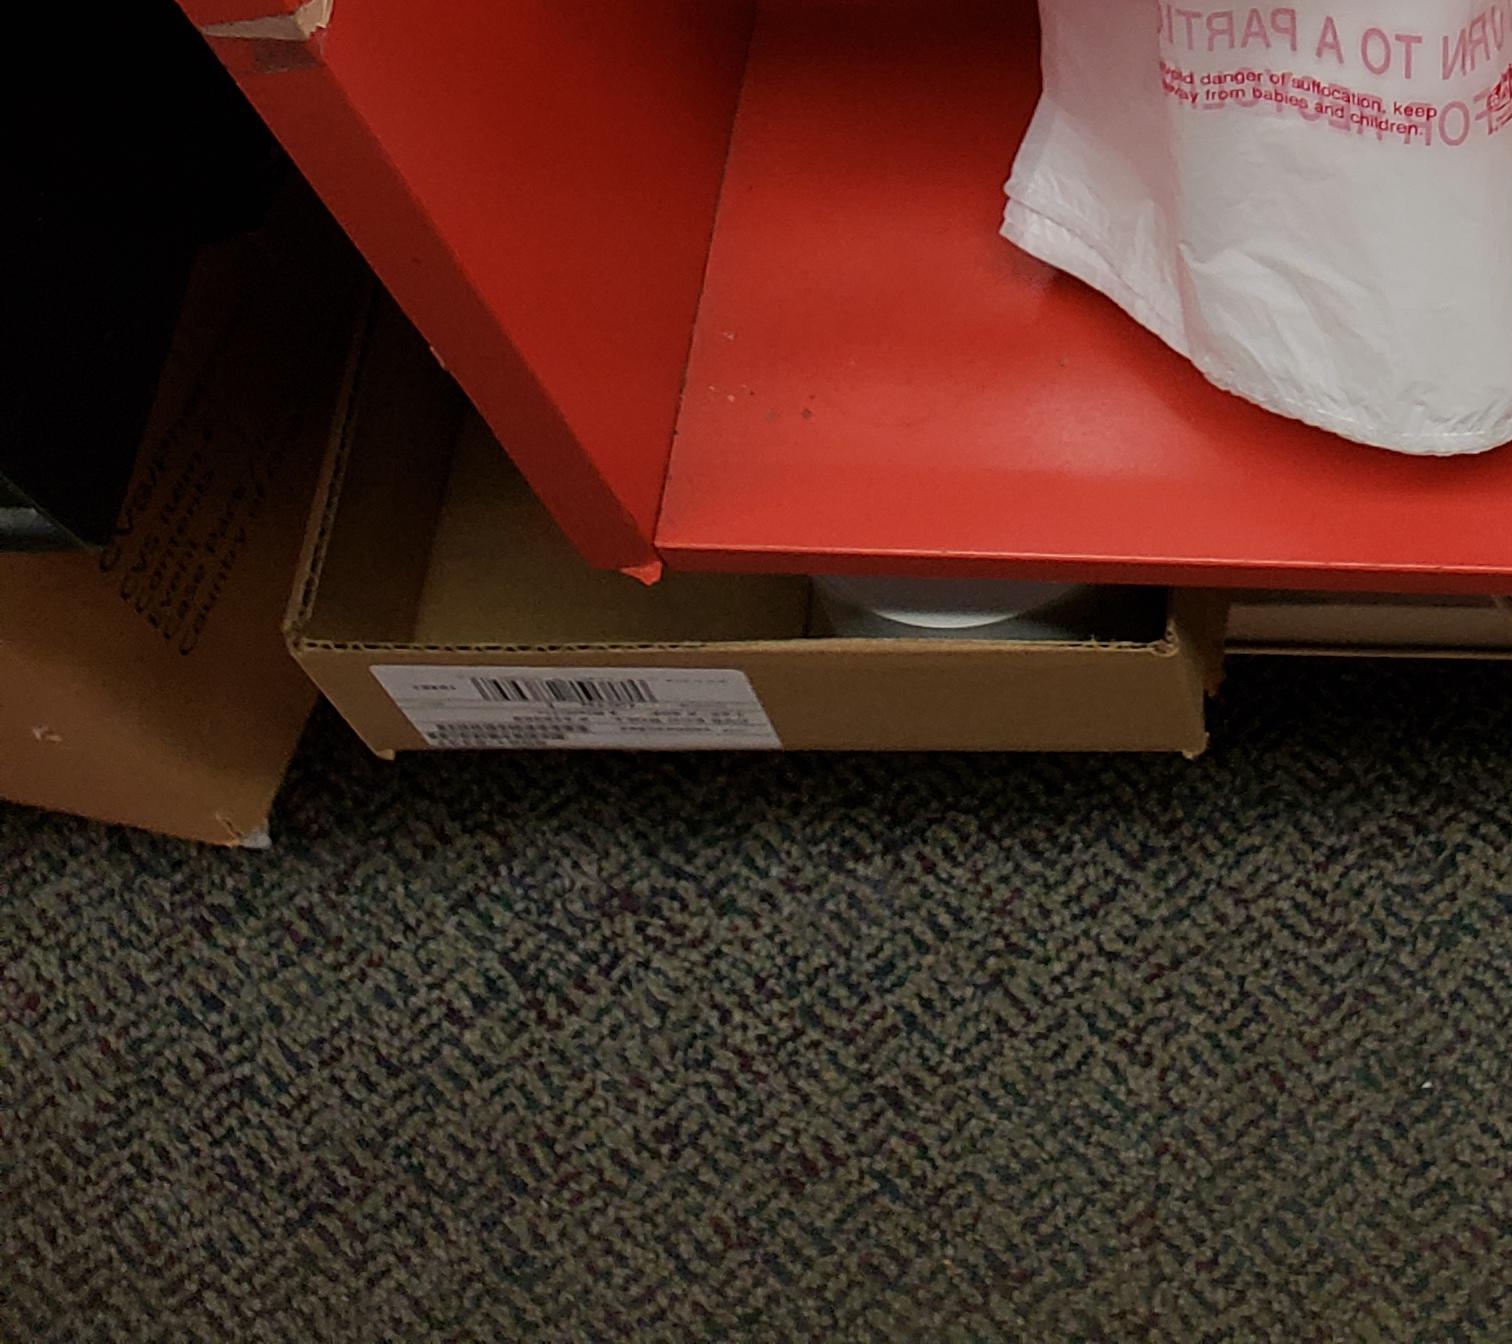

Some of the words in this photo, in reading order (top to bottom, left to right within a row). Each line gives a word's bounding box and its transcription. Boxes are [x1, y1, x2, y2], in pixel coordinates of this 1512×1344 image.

[1200, 68, 1262, 85] danger
[1269, 72, 1286, 85] of
[1292, 77, 1387, 114] suffocation,
[1393, 101, 1437, 120] keep
[1205, 87, 1245, 102] from
[1252, 87, 1308, 109] babies
[1315, 103, 1345, 119] and
[1350, 111, 1423, 136] children.
